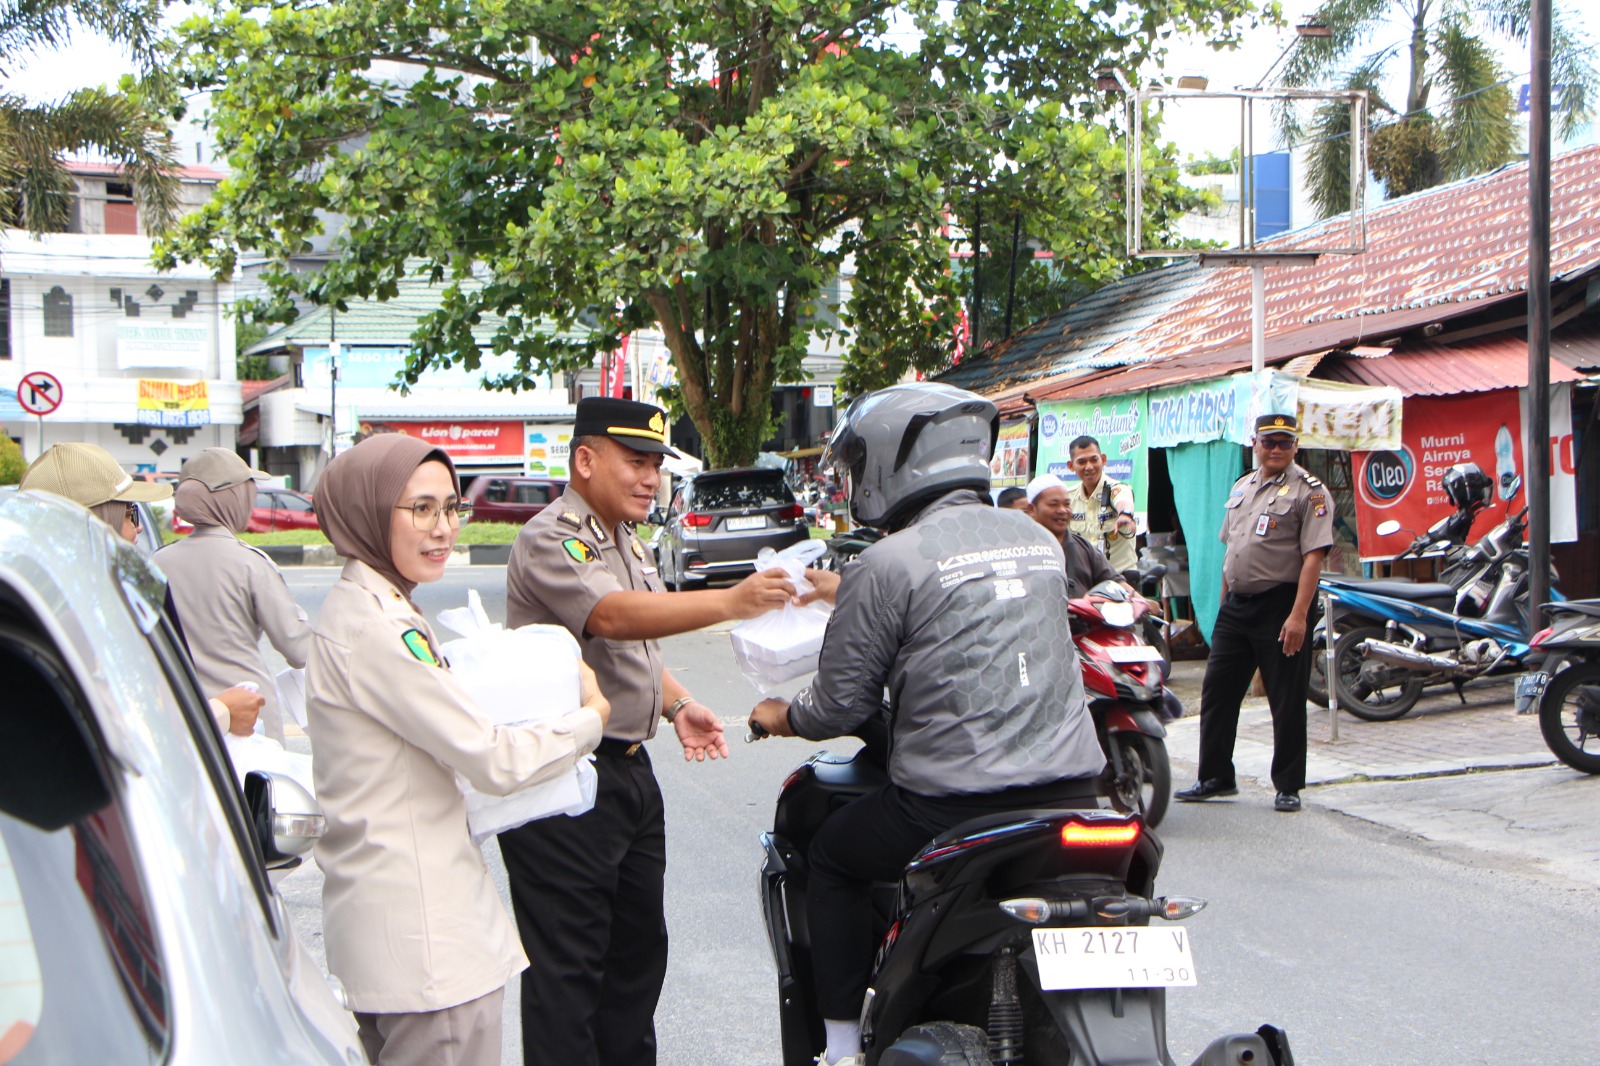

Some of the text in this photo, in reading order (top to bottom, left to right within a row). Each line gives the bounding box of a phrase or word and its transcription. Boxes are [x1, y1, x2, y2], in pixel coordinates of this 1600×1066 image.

[348, 352, 381, 362] SEGO
[1152, 386, 1236, 440] TOKO FARISA
[422, 427, 499, 438] Lion parcel
[1420, 433, 1465, 449] Murni
[550, 445, 569, 454] SEGO
[1422, 449, 1471, 463] Airnya
[1371, 462, 1405, 488] Cleo
[1037, 931, 1184, 955] KH 2127 V
